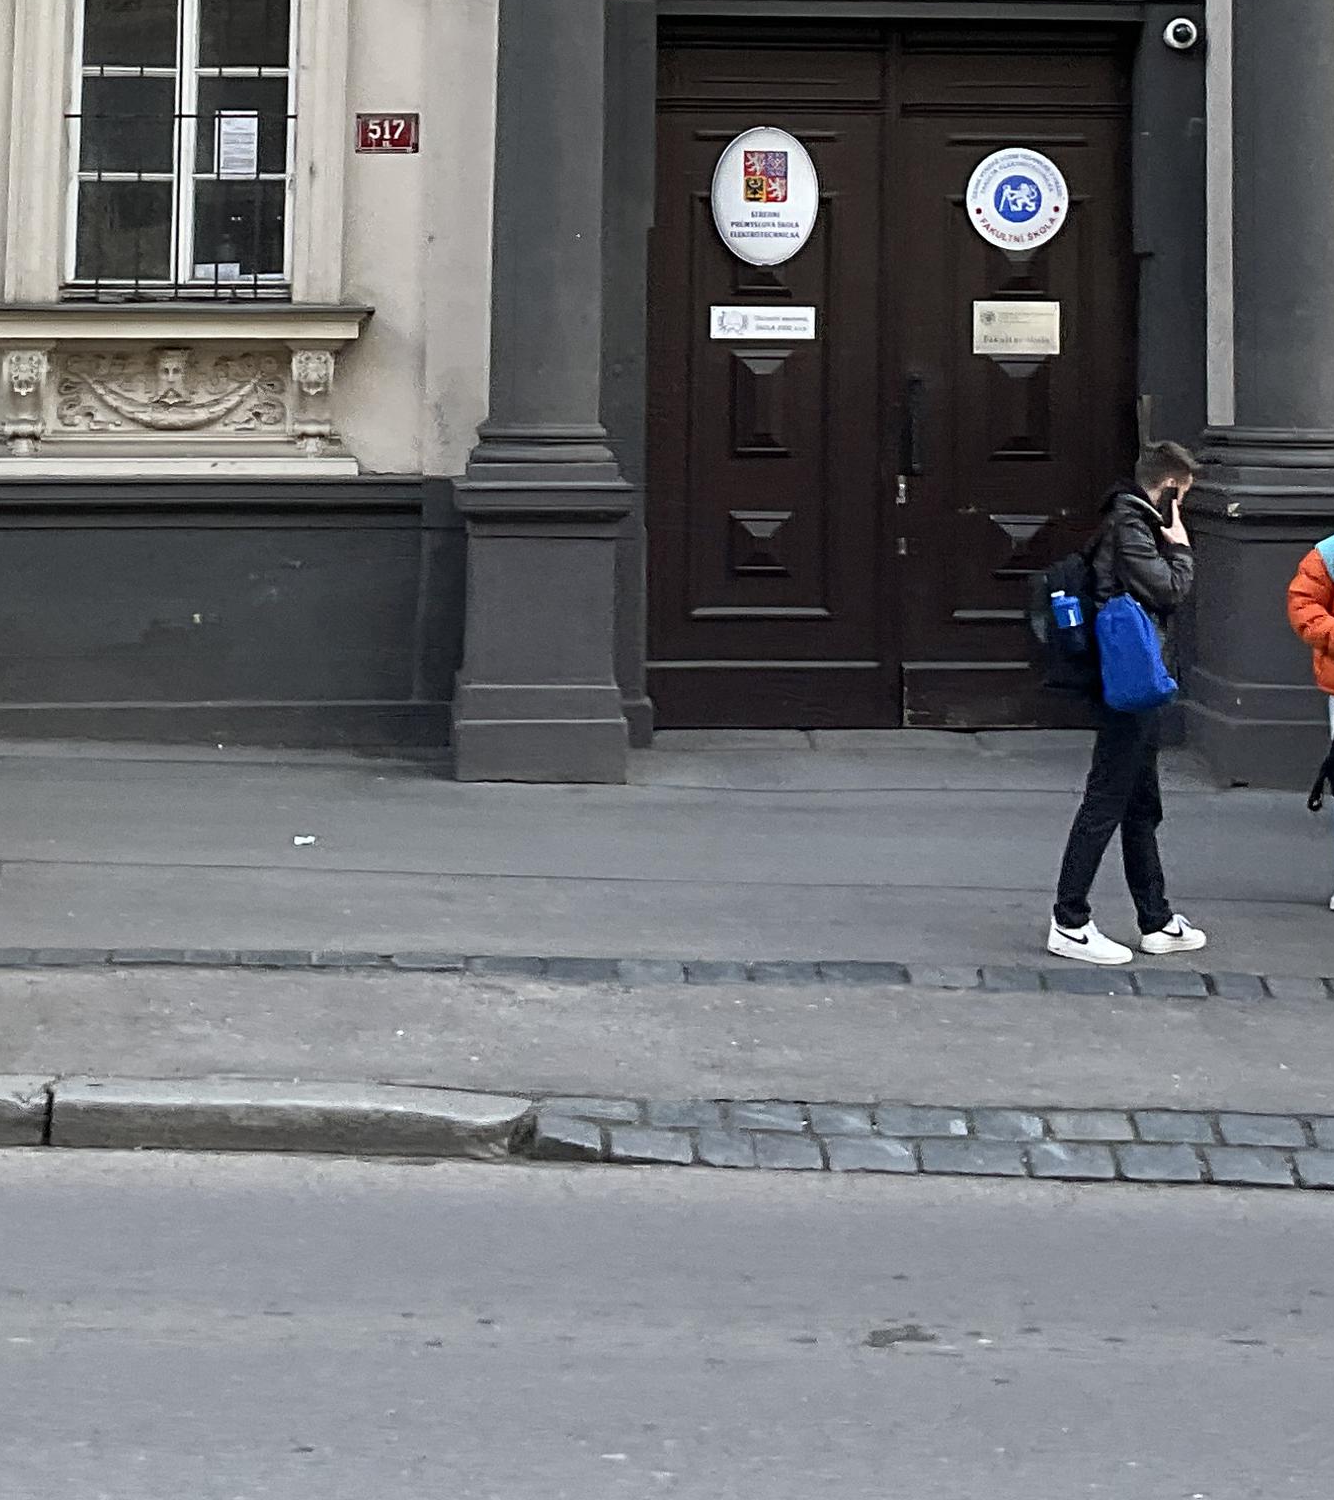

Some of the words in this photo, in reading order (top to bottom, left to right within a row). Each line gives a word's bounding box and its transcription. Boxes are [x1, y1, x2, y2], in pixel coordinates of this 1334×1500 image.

[367, 119, 405, 140] 517
[979, 217, 1025, 244] FAKULTNÍ
[1027, 217, 1056, 241] ŠKOLA
